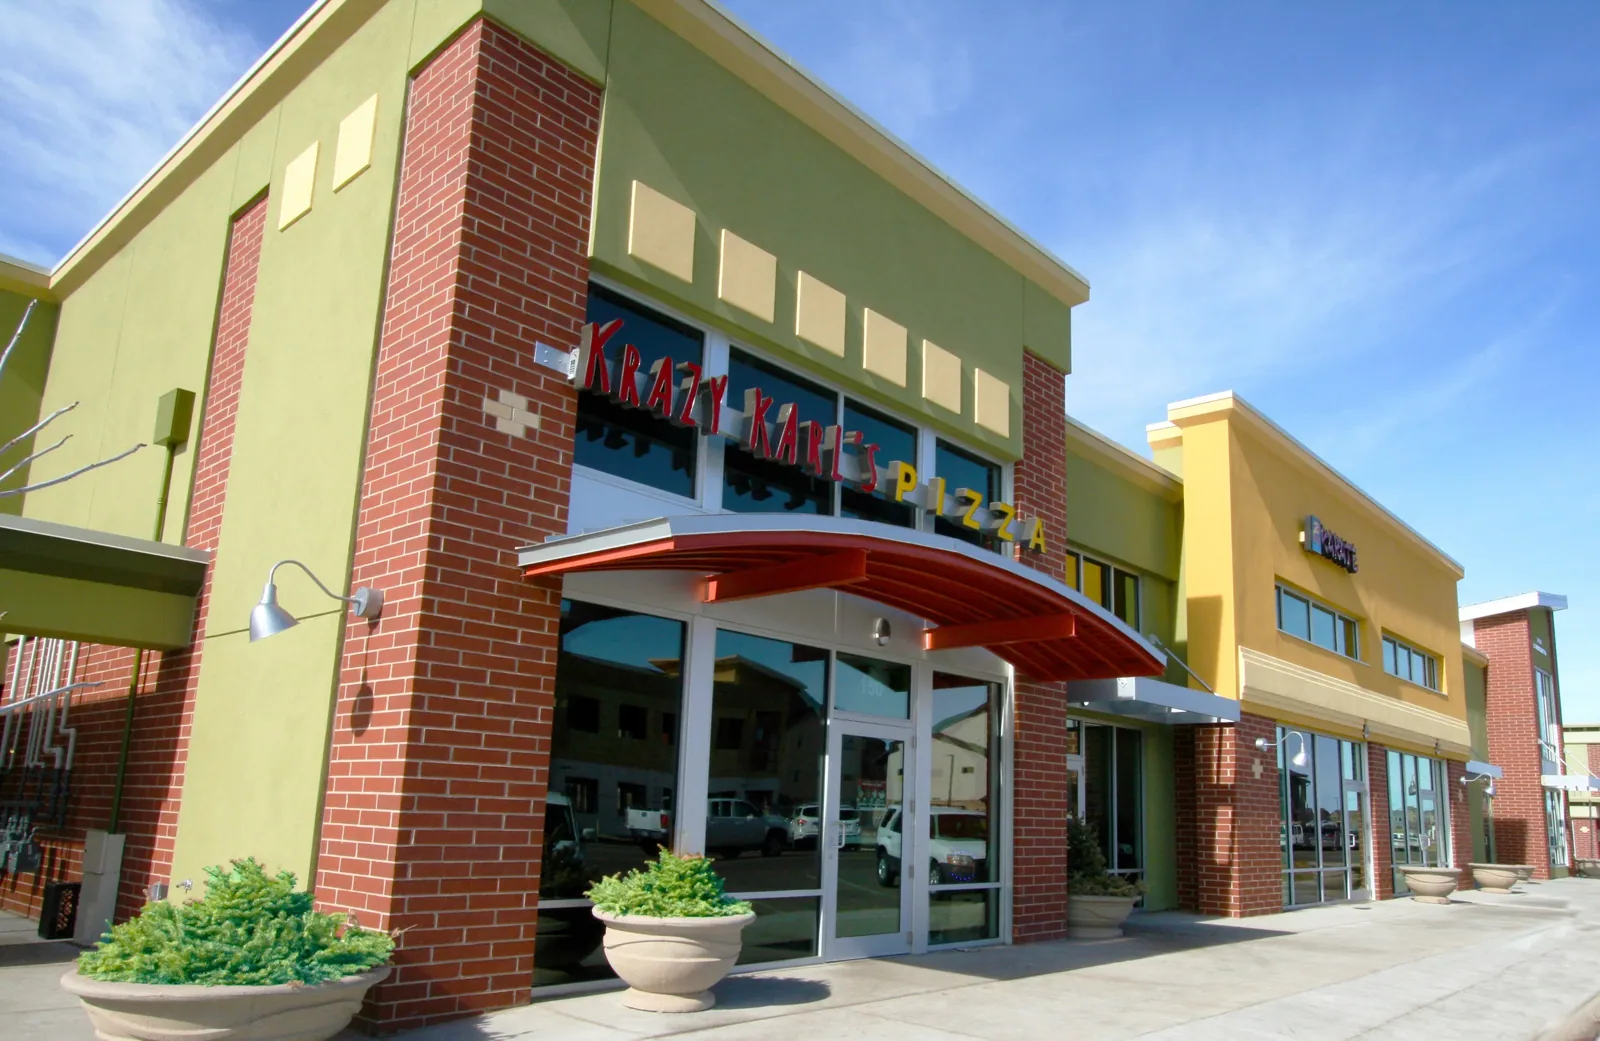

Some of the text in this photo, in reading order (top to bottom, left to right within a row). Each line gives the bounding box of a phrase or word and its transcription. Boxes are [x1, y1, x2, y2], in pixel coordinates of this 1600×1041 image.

[580, 319, 1047, 554] KRAZY KARL'S PIZZA
